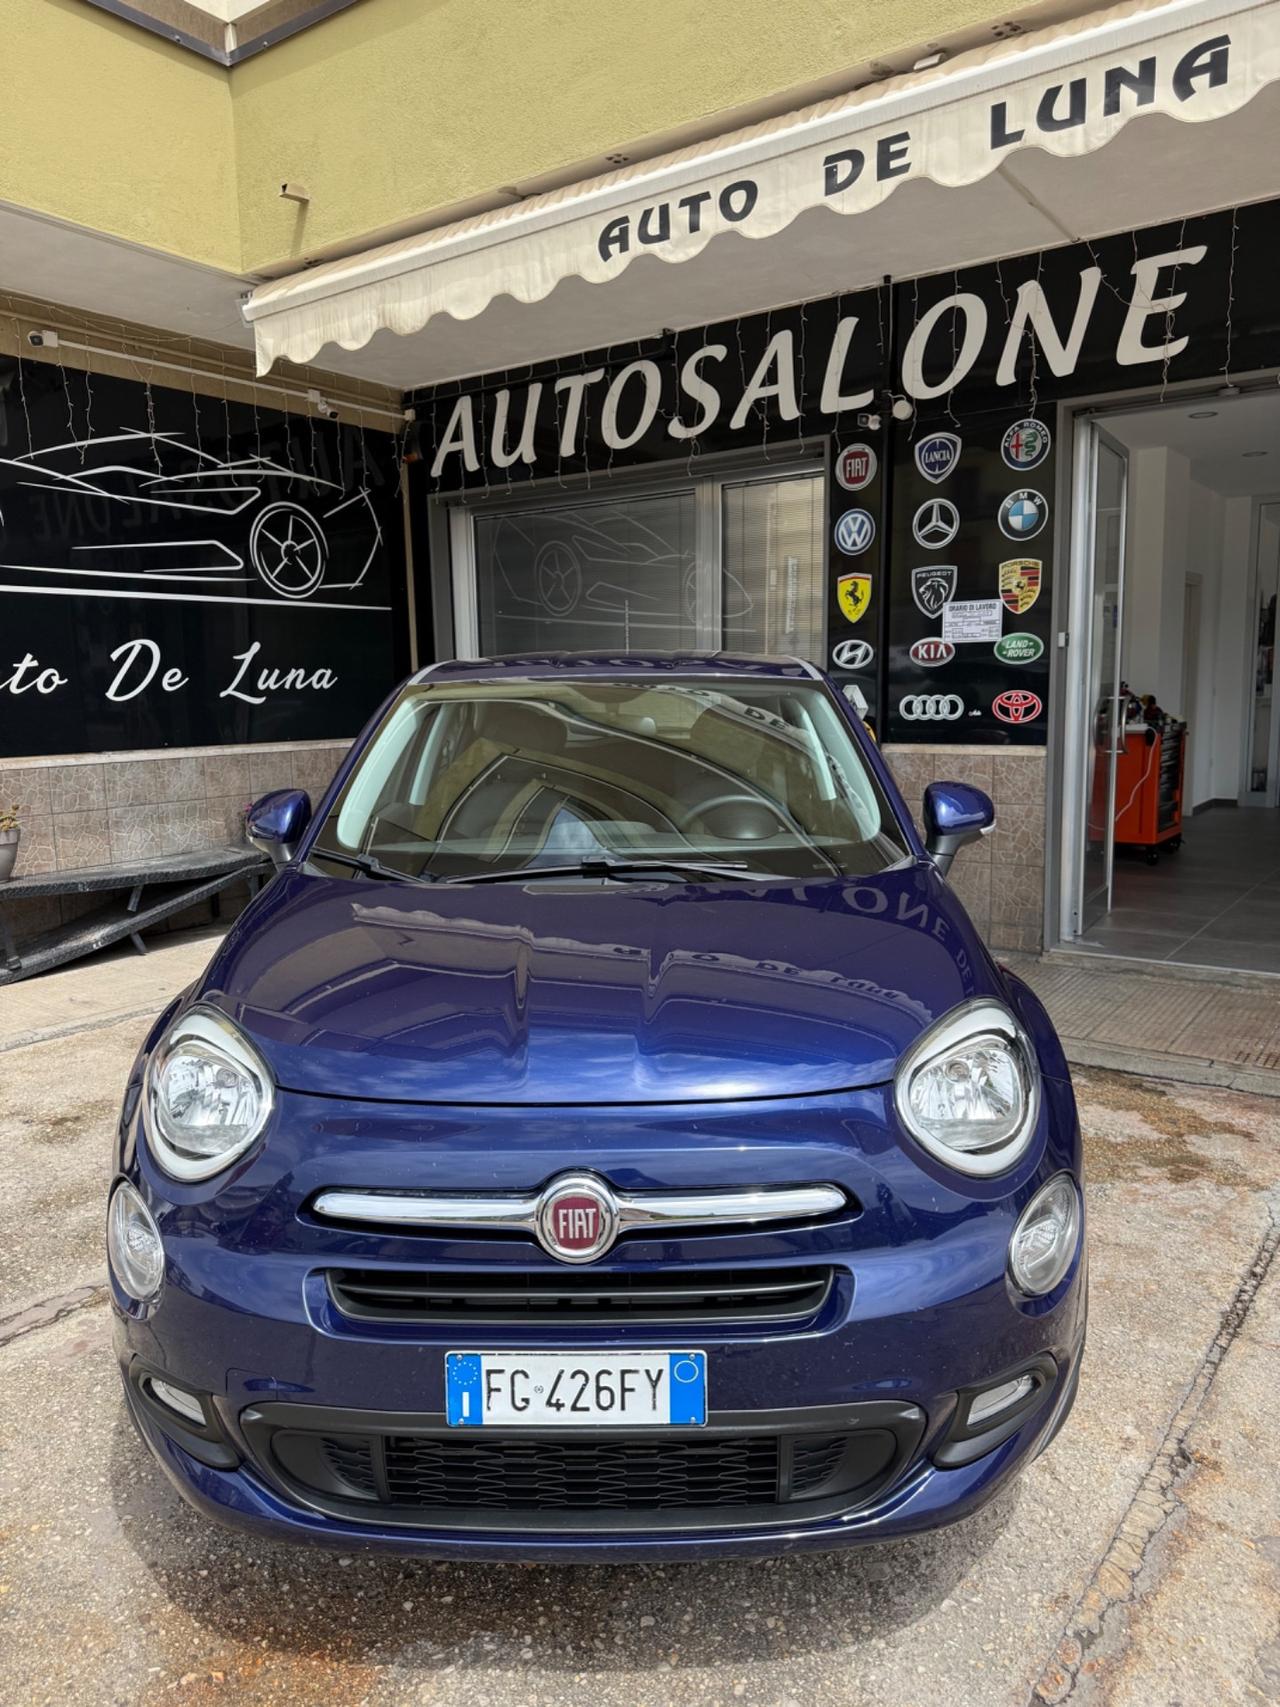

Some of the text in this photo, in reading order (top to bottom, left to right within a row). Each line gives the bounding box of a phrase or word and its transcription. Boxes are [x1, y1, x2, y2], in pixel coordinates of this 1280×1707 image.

[598, 33, 1231, 262] AUTO DE LUNA
[430, 245, 1208, 478] AUTOSALONE
[1004, 421, 1048, 448] ALFA ROMEO
[845, 457, 868, 479] FIAT
[925, 449, 951, 464] LANCIA
[1005, 492, 1043, 509] BMW
[918, 643, 947, 659] KIA
[0, 638, 338, 704] to De Luna
[558, 1208, 597, 1239] FIAT
[485, 1369, 531, 1411] FG
[545, 1368, 664, 1411] 426FY
